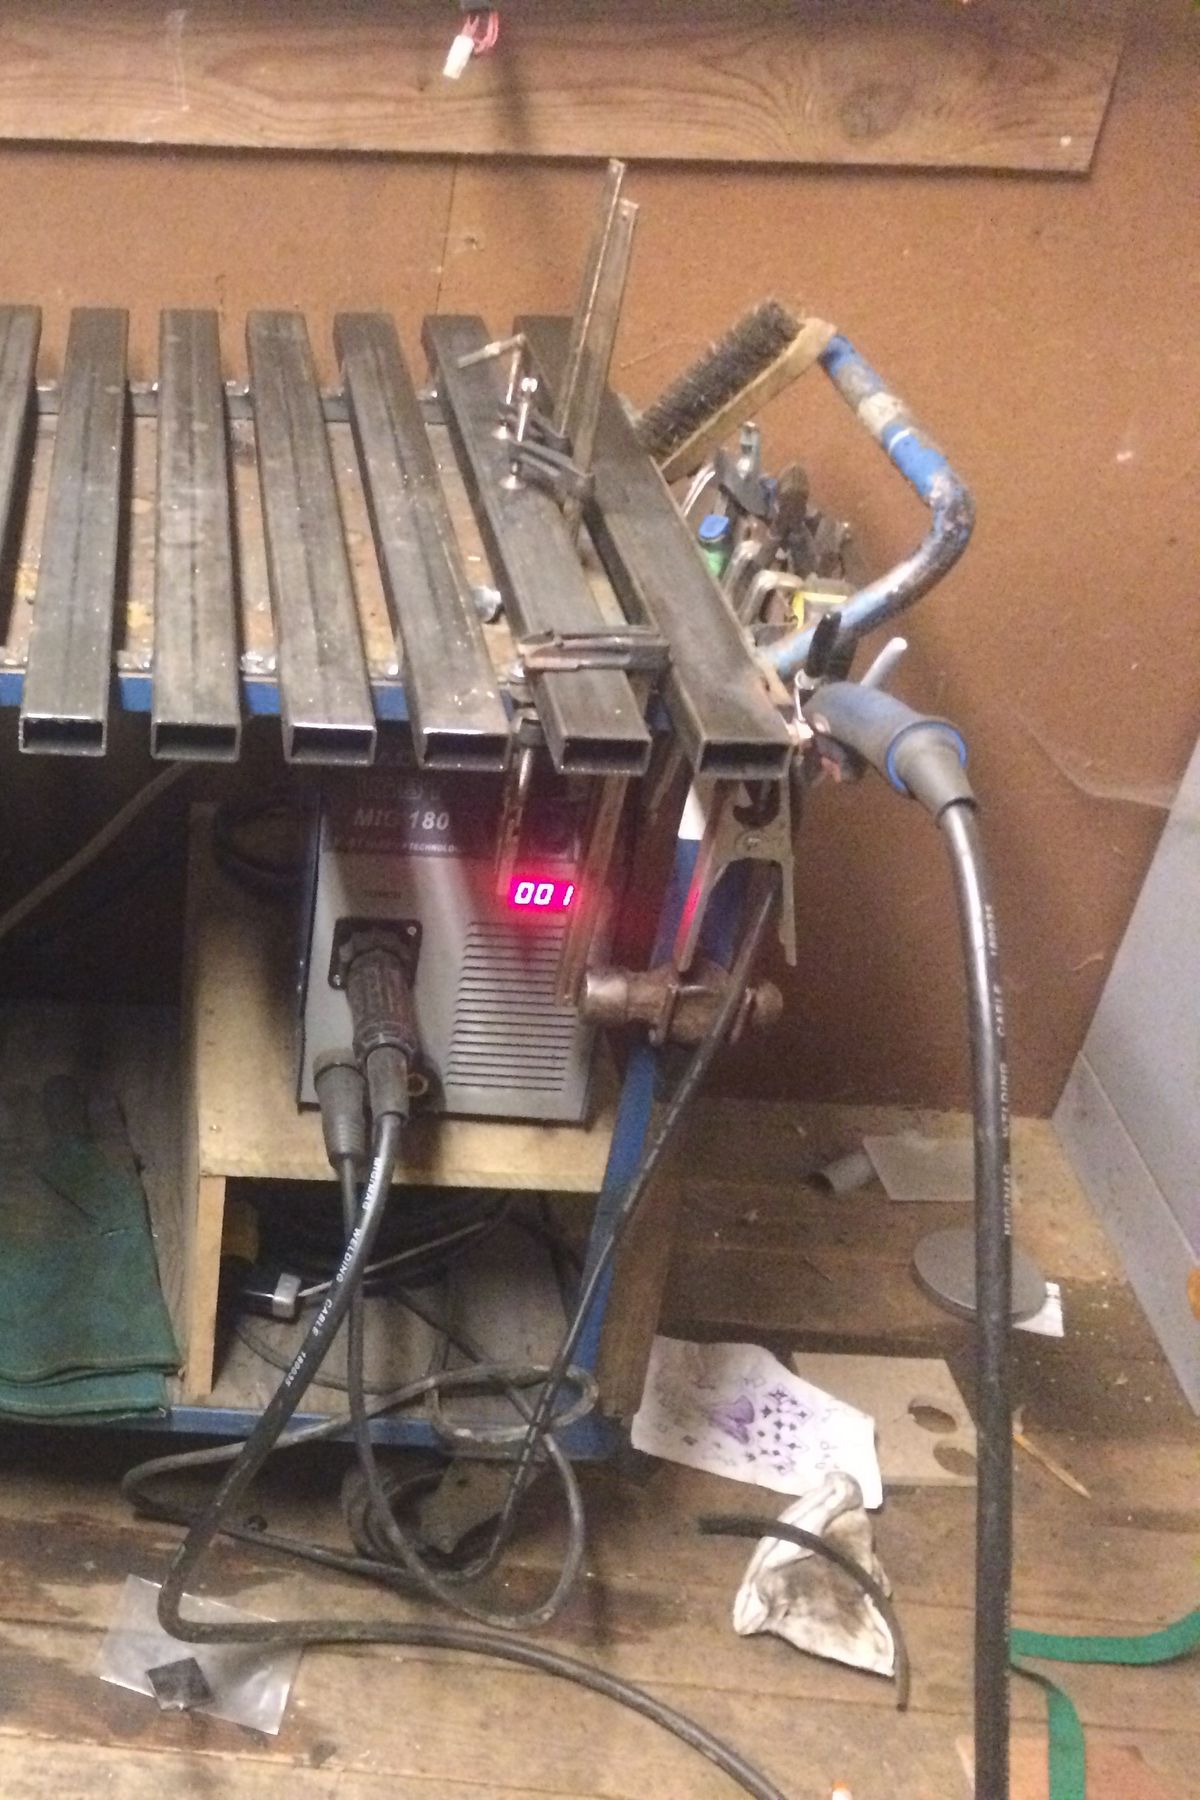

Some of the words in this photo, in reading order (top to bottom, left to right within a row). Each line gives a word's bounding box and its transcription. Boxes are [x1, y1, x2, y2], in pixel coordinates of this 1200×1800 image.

[408, 810, 450, 831] 180
[408, 841, 460, 854] TECHNOLO
[514, 881, 575, 907] 001
[336, 1227, 361, 1283] WELDING
[312, 1298, 333, 1337] CABLE
